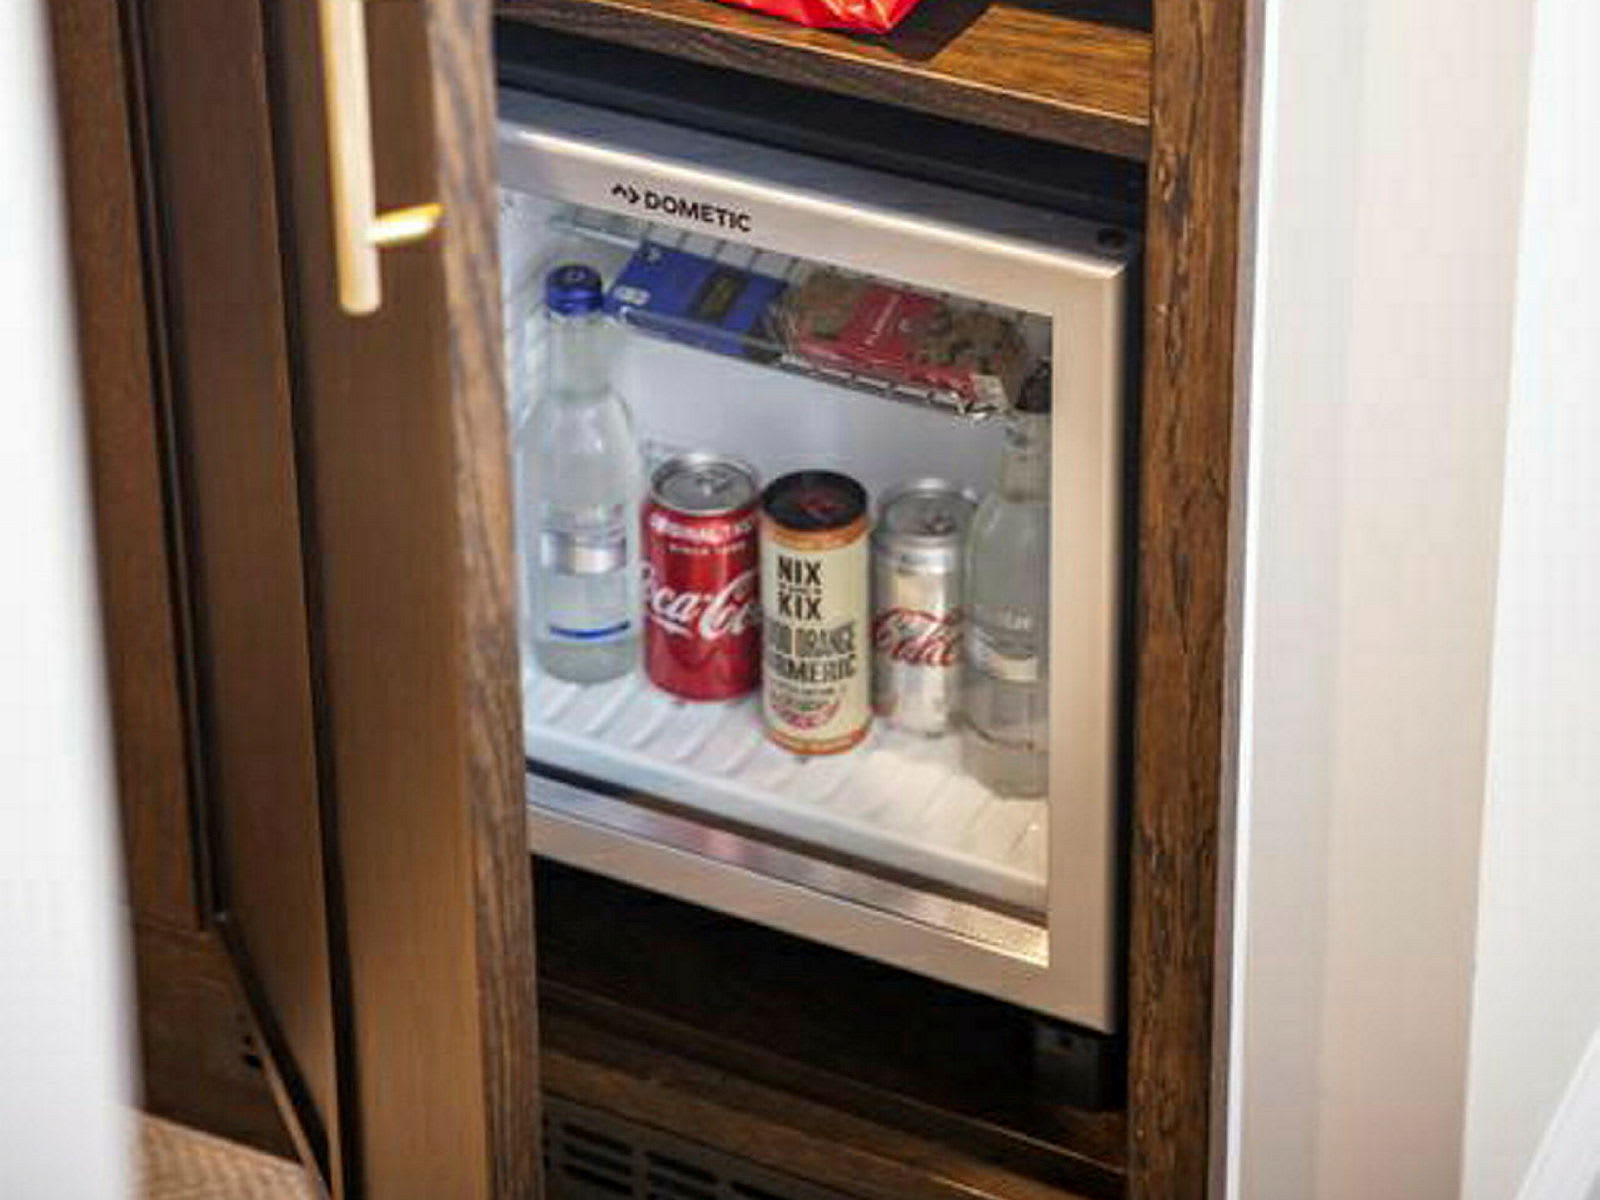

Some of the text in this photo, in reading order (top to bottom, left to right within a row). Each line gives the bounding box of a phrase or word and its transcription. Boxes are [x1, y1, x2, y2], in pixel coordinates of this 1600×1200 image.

[644, 190, 752, 232] DOMETIC
[777, 555, 822, 586] NIX
[777, 592, 822, 620] KIX
